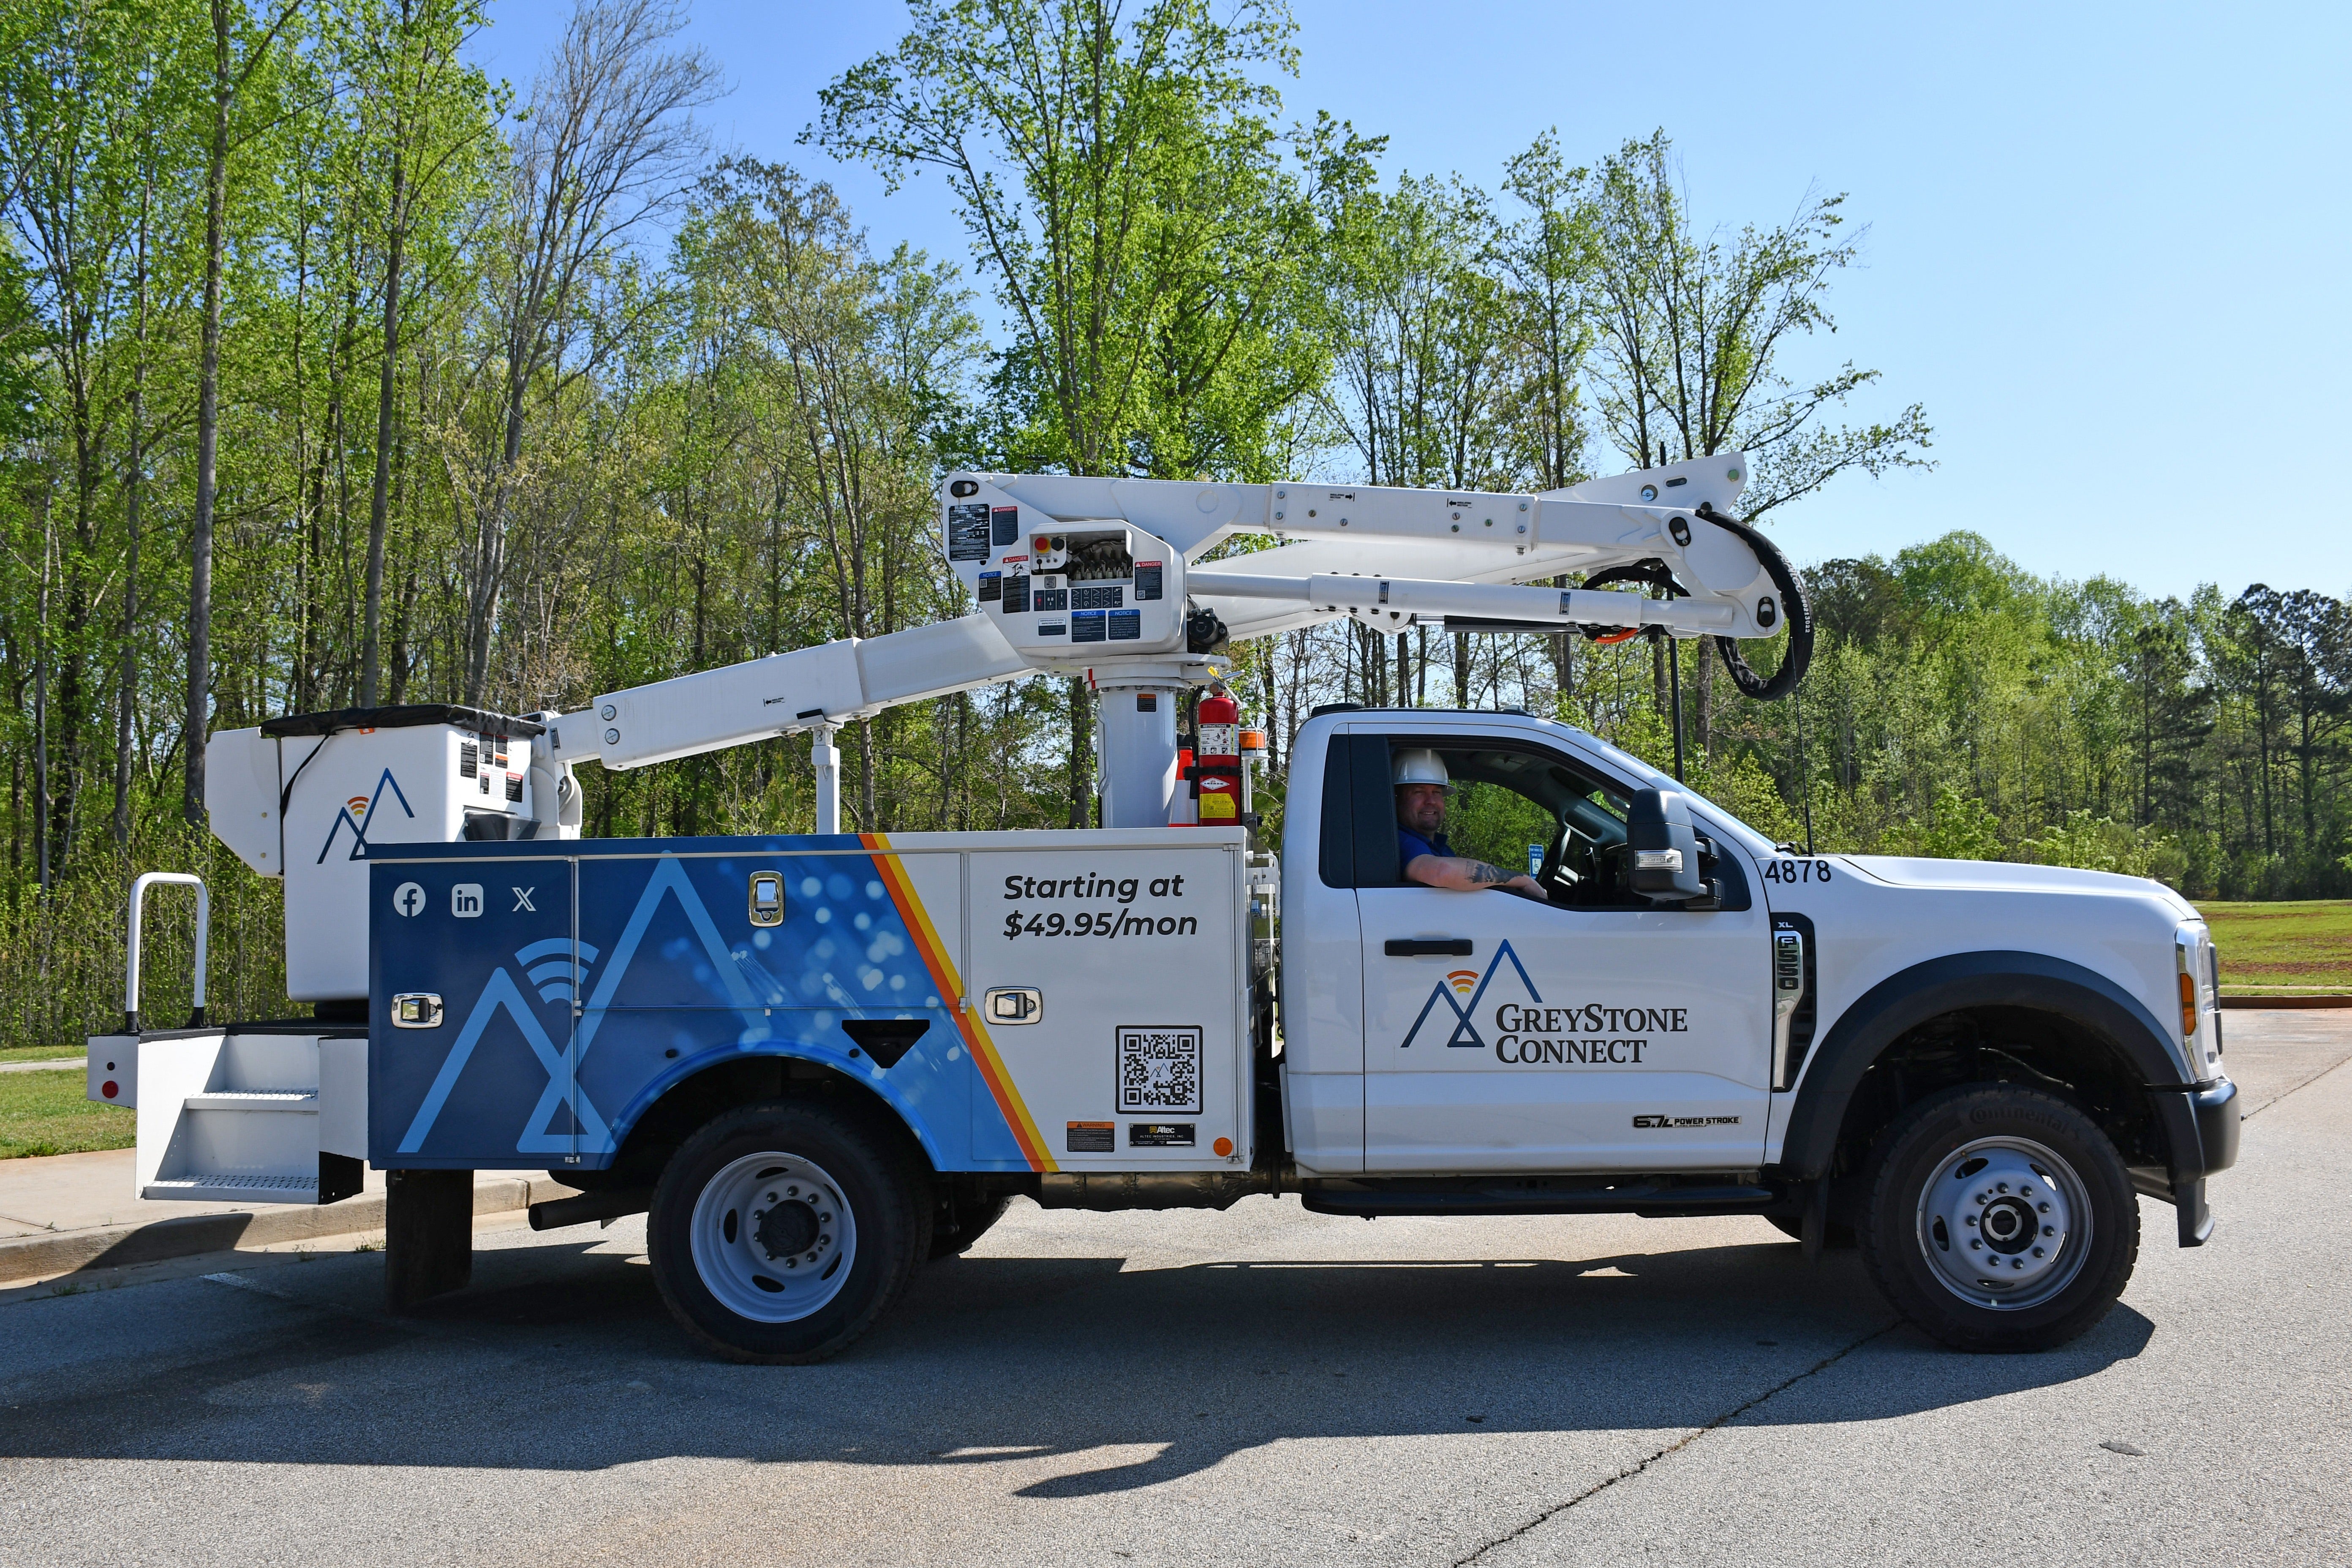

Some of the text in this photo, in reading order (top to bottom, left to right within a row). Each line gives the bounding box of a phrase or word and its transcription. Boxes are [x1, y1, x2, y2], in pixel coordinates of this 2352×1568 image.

[1783, 562, 1805, 593] Altec
[1765, 860, 1832, 884] 4878
[1004, 872, 1184, 903] Starting at
[1003, 908, 1198, 941] $49.95/mon
[1157, 1126, 1176, 1134] Altec
[1633, 1115, 1673, 1128] 6.7L
[1969, 1106, 2069, 1134] Continental
